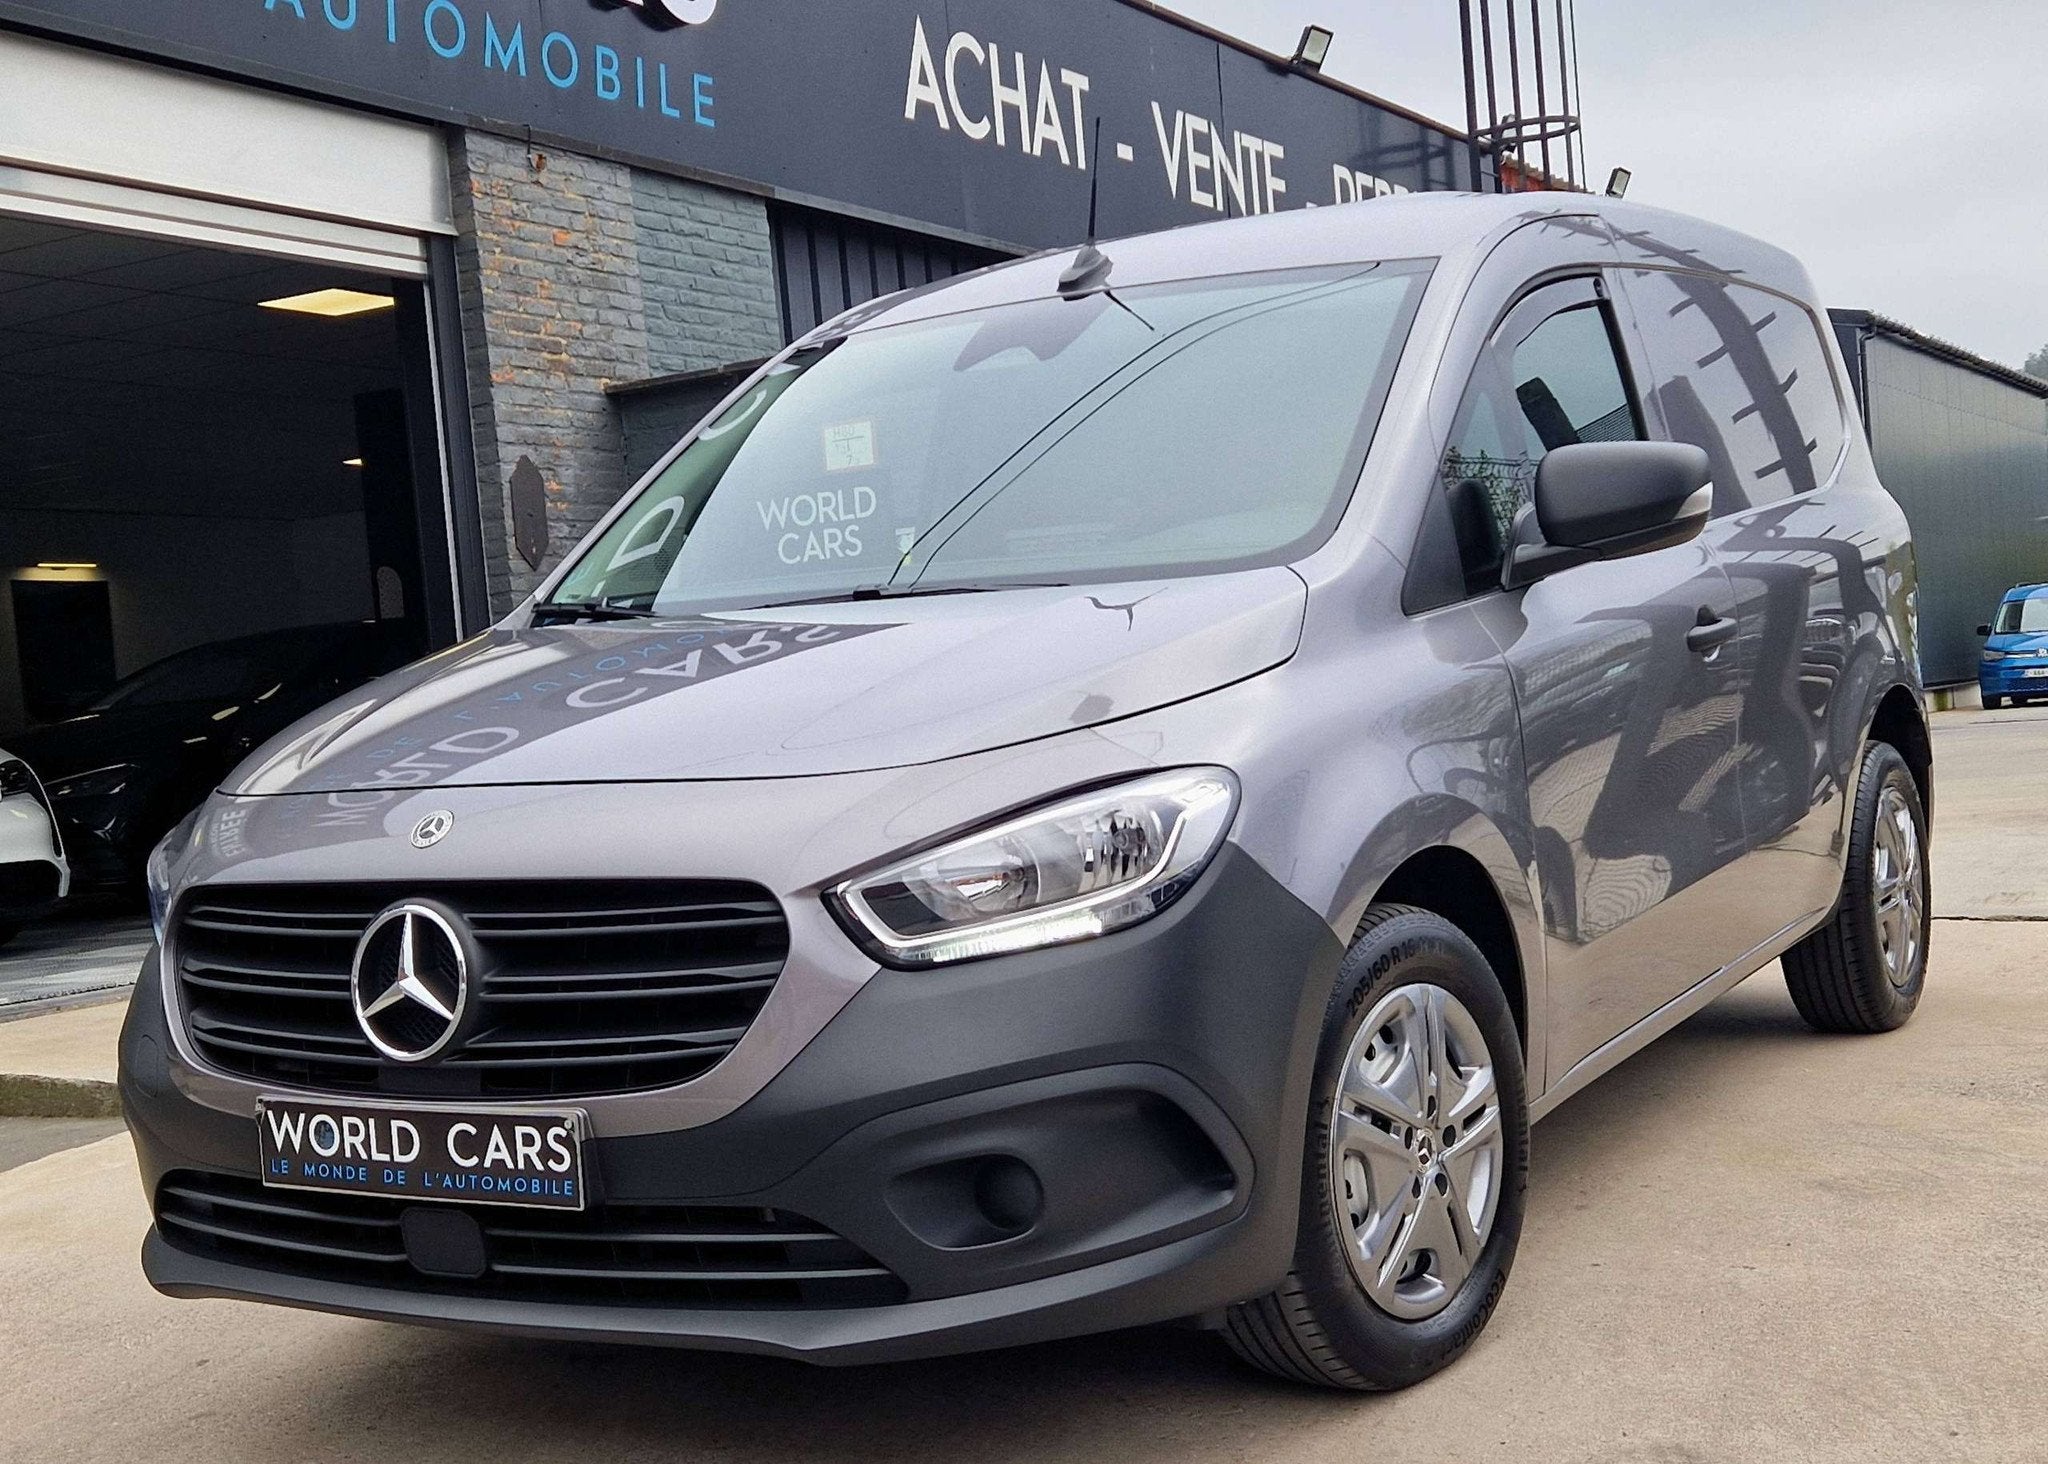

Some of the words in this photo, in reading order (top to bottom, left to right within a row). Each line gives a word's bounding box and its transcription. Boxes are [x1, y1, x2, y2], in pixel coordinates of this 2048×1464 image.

[264, 0, 716, 128] UTOMOBILE
[904, 14, 1090, 170] ACHAT
[1151, 101, 1287, 216] VENTE
[756, 486, 877, 530] WORLD
[778, 524, 863, 565] CARS
[266, 1109, 420, 1164] WORLD
[447, 1122, 572, 1174] CARS
[271, 1158, 289, 1175] LE
[304, 1163, 367, 1182] MONDE
[383, 1169, 406, 1185] DE
[424, 1173, 573, 1197] L'AUTOMOBILE
